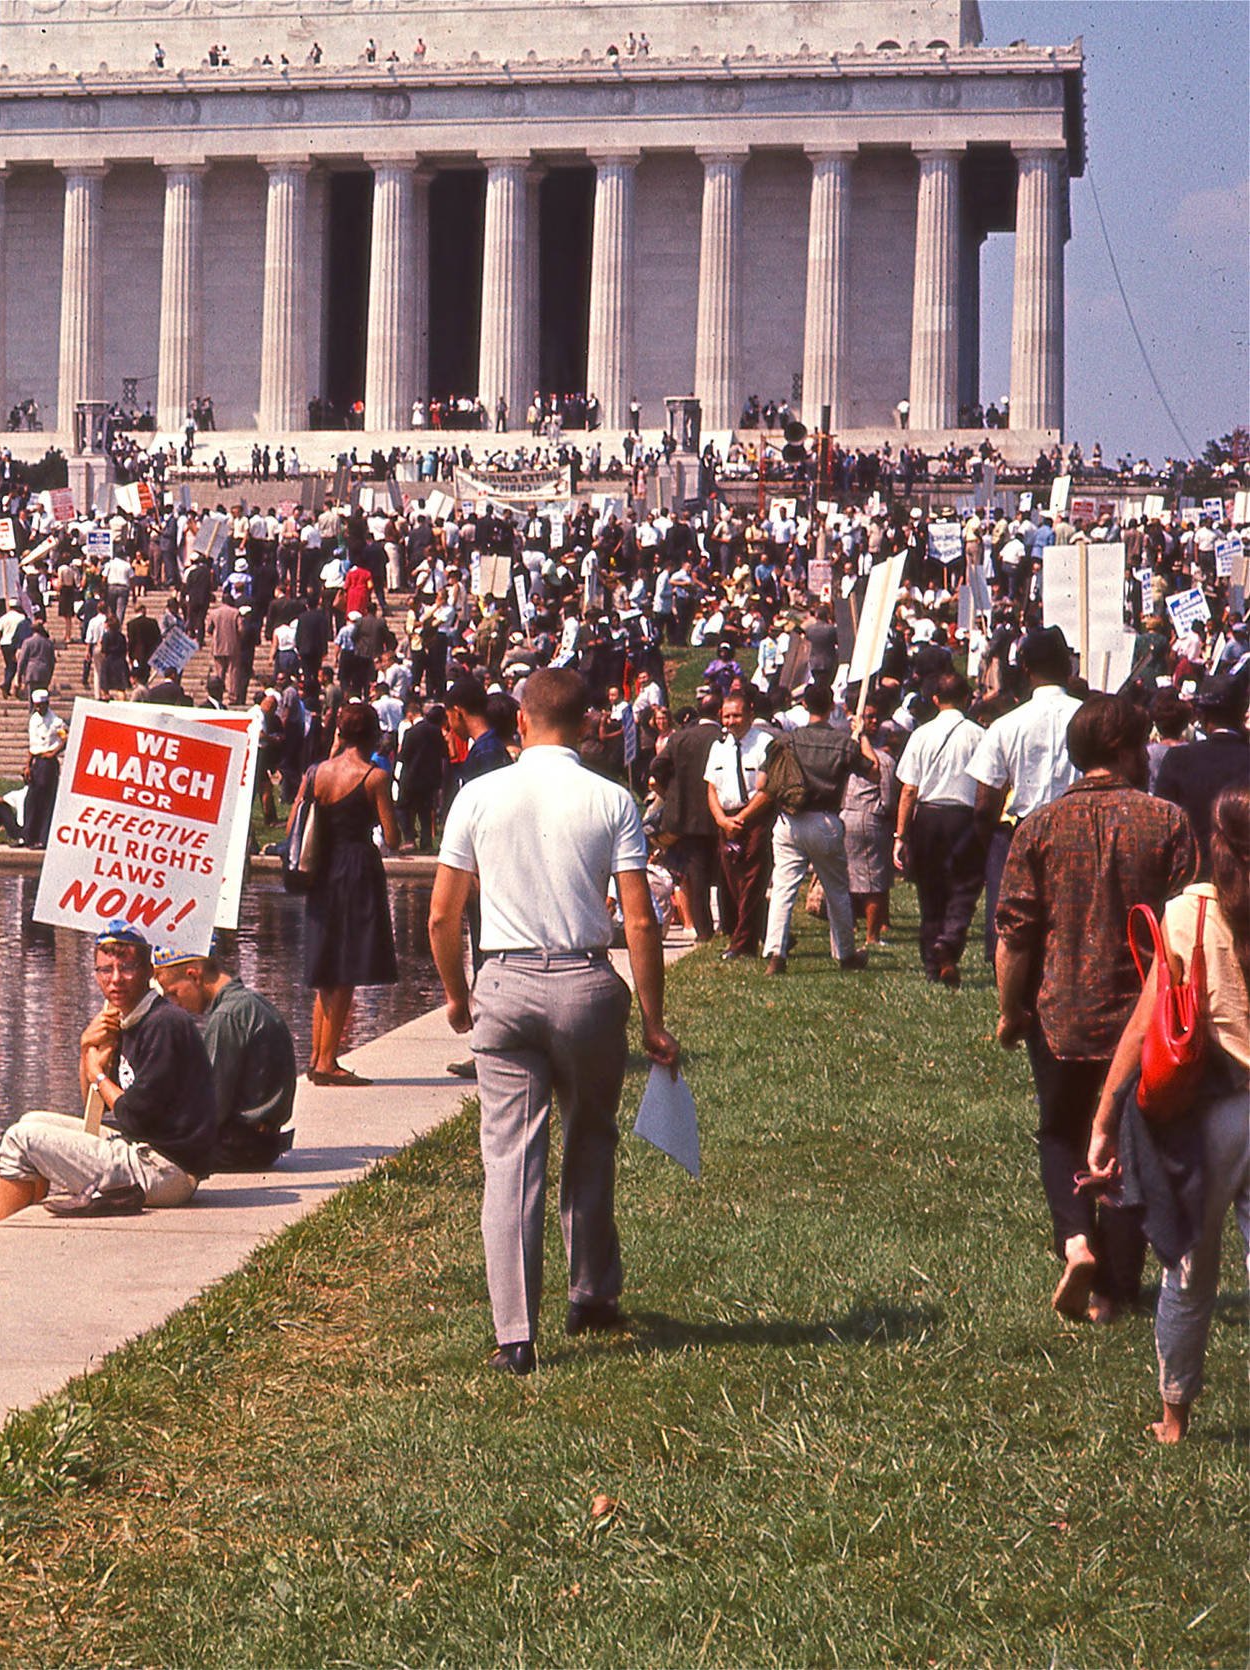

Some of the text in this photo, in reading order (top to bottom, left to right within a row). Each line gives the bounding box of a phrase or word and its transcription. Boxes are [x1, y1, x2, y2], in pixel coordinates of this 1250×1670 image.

[136, 731, 181, 760] WE
[85, 749, 215, 801] MARCH
[122, 787, 172, 810] FOR
[78, 807, 210, 850] EFFECTIVE
[57, 826, 215, 875] CIVIL RIGHTS
[93, 857, 167, 889] LAWS
[58, 880, 197, 933] NOW!
